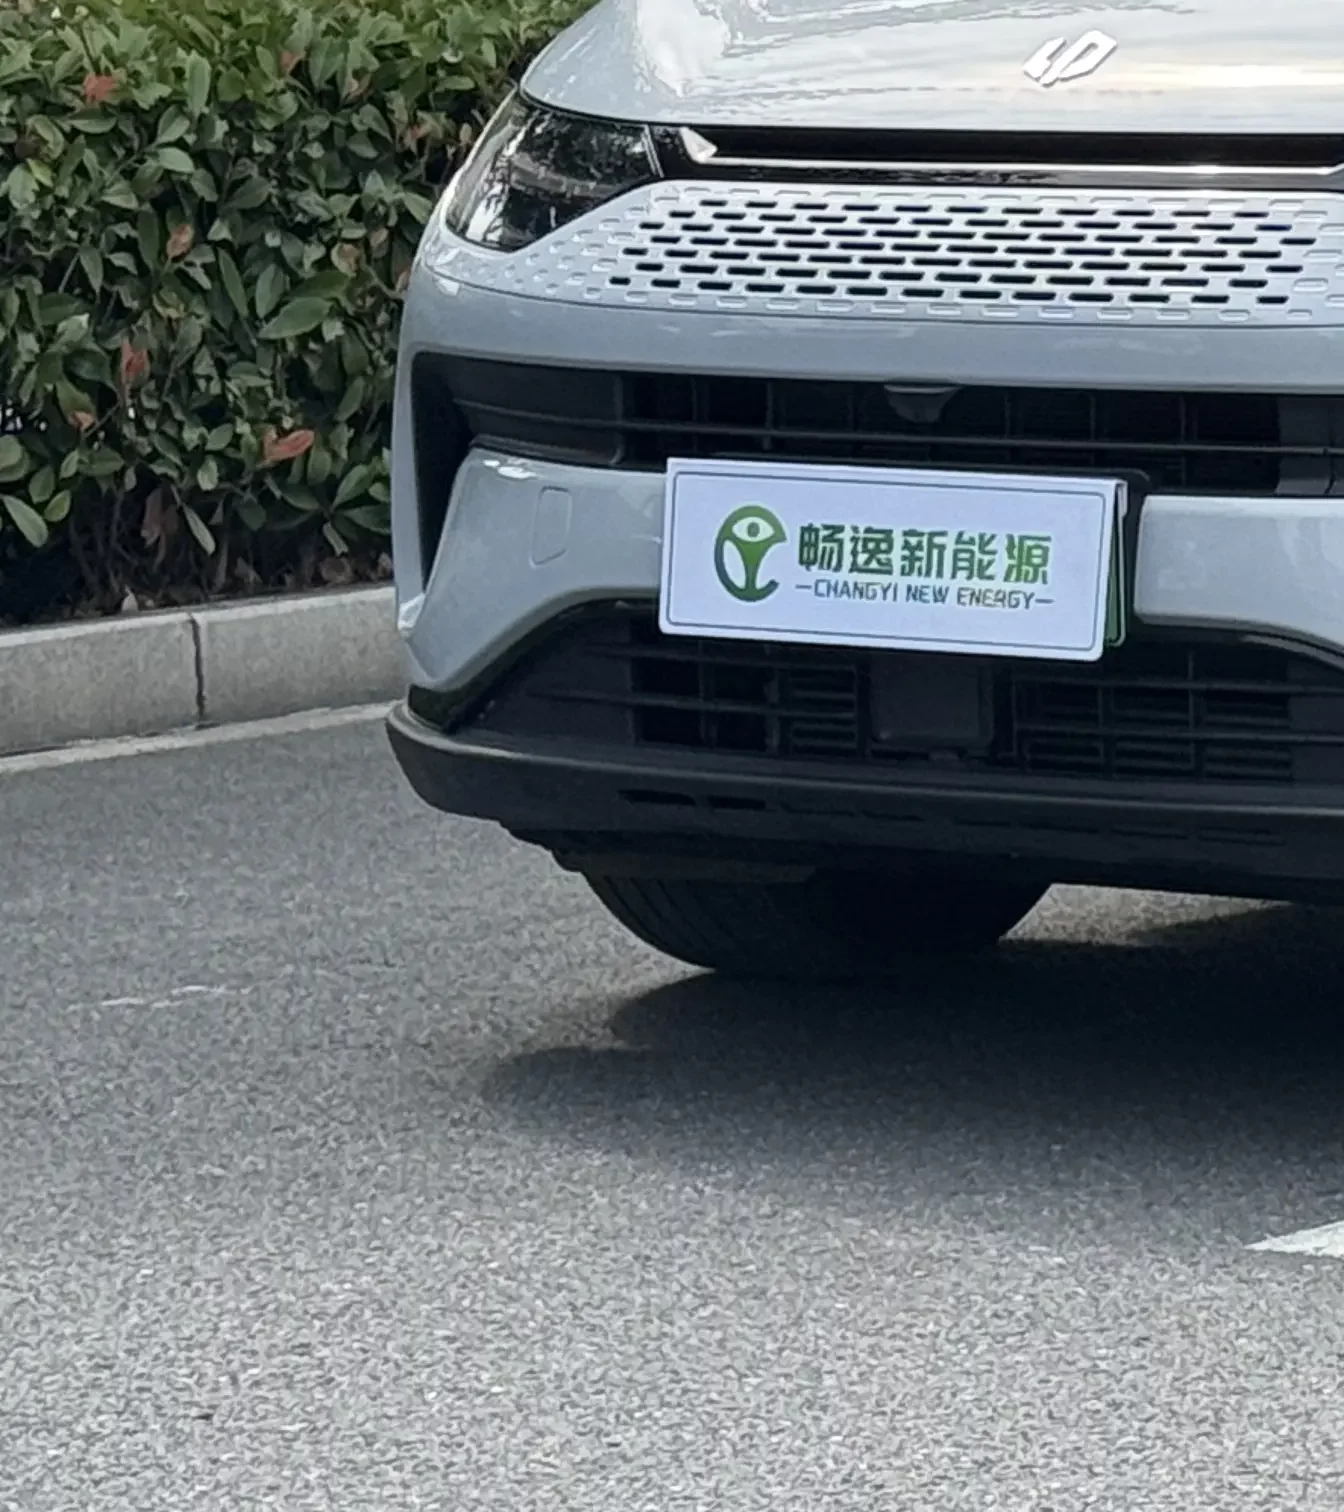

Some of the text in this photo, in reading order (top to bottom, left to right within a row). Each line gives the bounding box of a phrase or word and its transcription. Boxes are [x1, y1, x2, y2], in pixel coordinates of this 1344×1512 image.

[798, 522, 1052, 585] 畅逸新能源
[813, 578, 1036, 610] CHANGYI NEW ENERGY
